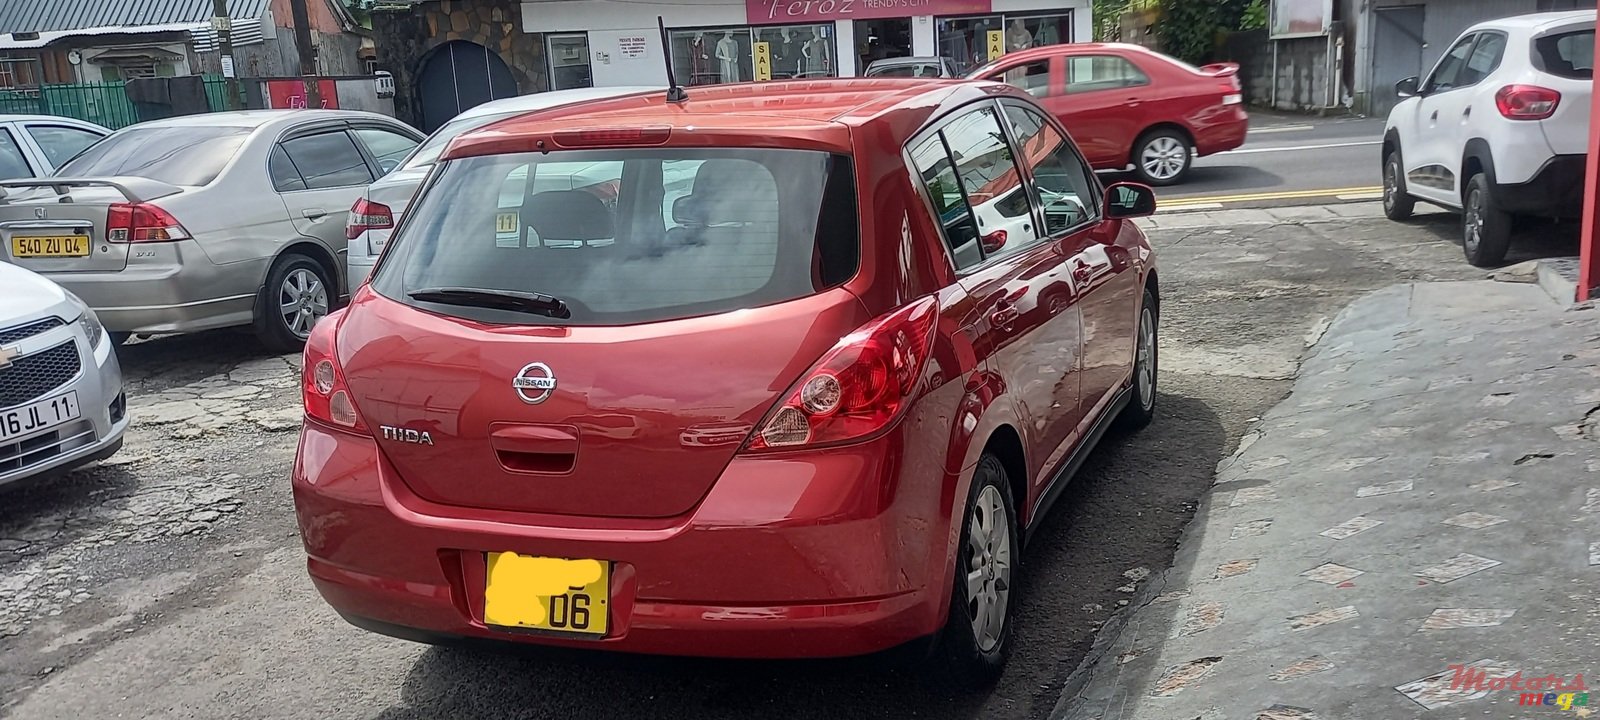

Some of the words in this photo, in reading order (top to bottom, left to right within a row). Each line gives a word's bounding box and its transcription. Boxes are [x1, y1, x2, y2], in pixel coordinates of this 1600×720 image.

[763, 0, 854, 19] Feroz
[758, 45, 767, 81] SAL
[19, 238, 41, 254] 540
[45, 239, 61, 254] ZU
[65, 237, 81, 254] 04
[515, 377, 551, 388] NISSAN
[25, 406, 47, 430] JL
[52, 397, 70, 421] 11
[379, 425, 434, 446] TIIDA
[549, 593, 590, 630] 06
